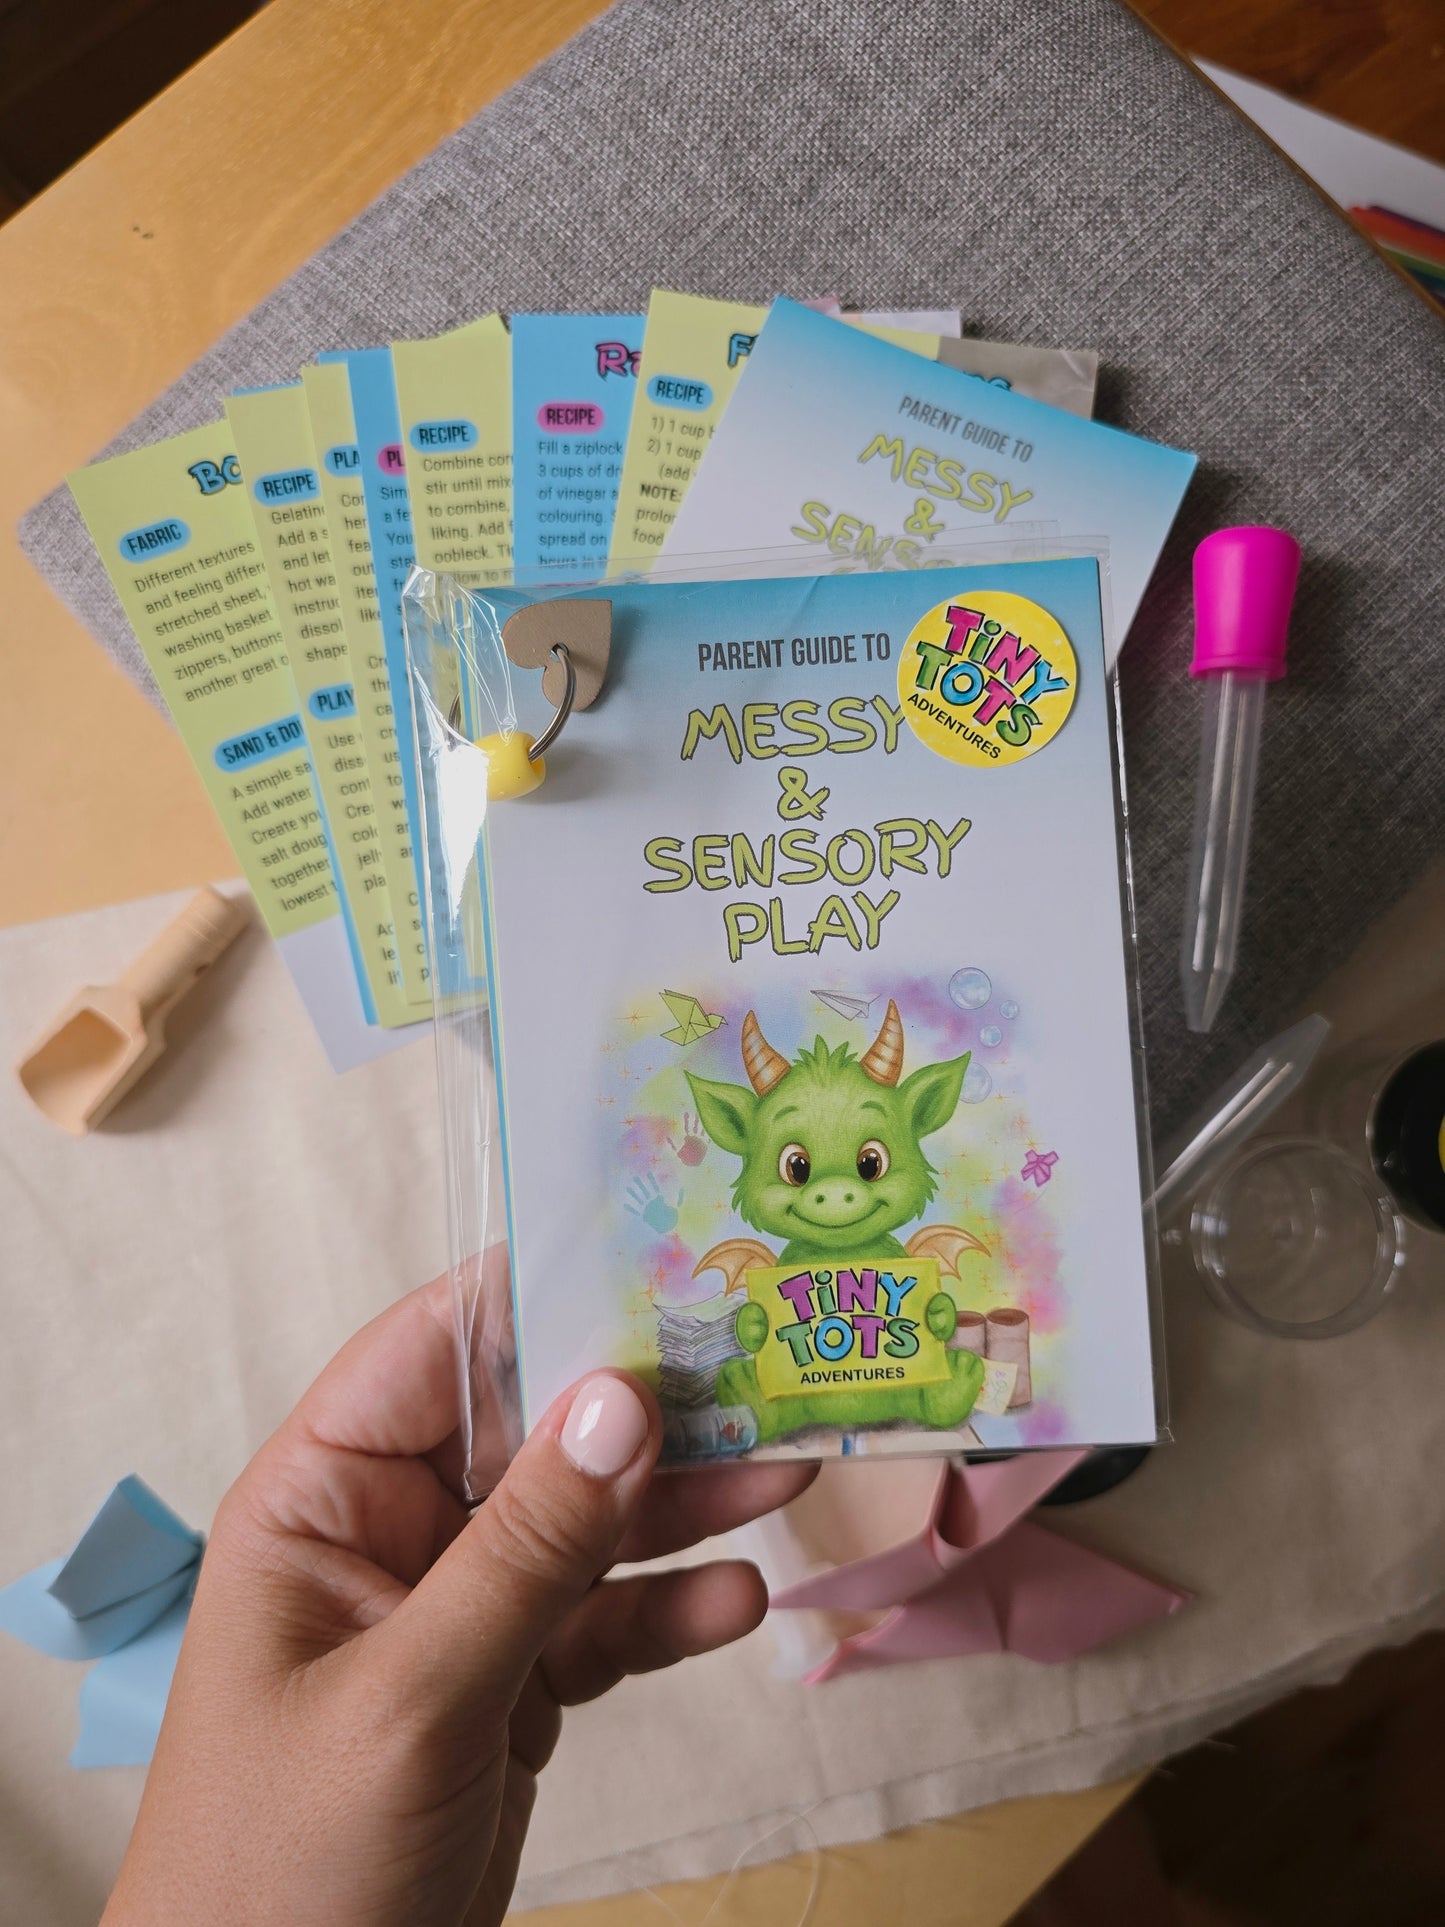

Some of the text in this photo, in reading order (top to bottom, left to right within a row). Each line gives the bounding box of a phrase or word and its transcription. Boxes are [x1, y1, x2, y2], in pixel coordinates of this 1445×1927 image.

[656, 380, 704, 404] RECIPE
[546, 408, 595, 425] RECIPE
[651, 417, 664, 433] 1)
[669, 419, 676, 432] 1
[680, 423, 704, 440] cup
[419, 425, 469, 445] RECIPE
[899, 397, 1034, 464] PARENT GUIDE TO
[539, 441, 622, 458] Fill a ziplock
[647, 439, 661, 455] 2)
[677, 445, 702, 461] cup
[423, 453, 484, 472] Combine
[539, 464, 546, 477] 3
[551, 467, 583, 481] cups
[588, 463, 601, 477] of
[659, 463, 690, 481] (add
[263, 474, 317, 499] RECIPE
[425, 480, 447, 495] stir
[452, 477, 483, 492] until
[857, 434, 1033, 523] MESSY
[539, 487, 553, 500] of
[557, 488, 606, 504] vinegar
[428, 505, 443, 518] to
[539, 510, 605, 527] colouring.
[904, 498, 945, 542] &
[127, 523, 182, 556] FABRIC
[278, 531, 306, 548] Add
[310, 531, 318, 542] a
[432, 525, 473, 543] liking.
[478, 522, 504, 536] Add
[539, 532, 607, 550] spread on
[633, 528, 664, 546] food
[134, 541, 256, 593] Different textures
[283, 550, 331, 571] and let
[434, 546, 494, 563] oobleck.
[539, 555, 576, 569] hours
[145, 596, 173, 614] and
[174, 577, 224, 604] feeling
[287, 578, 312, 595] hot
[154, 602, 221, 637] stretched
[164, 608, 273, 658] washing basket
[698, 632, 891, 672] PARENT GUIDE TO
[174, 652, 232, 681] zippers,
[185, 674, 239, 702] another
[242, 658, 279, 684] great
[916, 640, 1043, 748] TOTS
[680, 695, 905, 764] MESSY
[907, 693, 1002, 759] ADVENTURES
[222, 736, 266, 764] SAND
[265, 730, 279, 748] &
[327, 732, 356, 749] Use
[231, 786, 244, 800] A
[245, 766, 294, 798] simple
[776, 766, 830, 821] &
[242, 787, 312, 824] Add water
[251, 817, 299, 845] Create
[261, 844, 290, 868] salt
[643, 817, 972, 893] SENSORY
[271, 857, 331, 889] together
[281, 884, 328, 913] lowest
[722, 890, 900, 963] PLAY
[775, 1314, 920, 1368] TOTS
[800, 1366, 905, 1385] ADVENTURES
